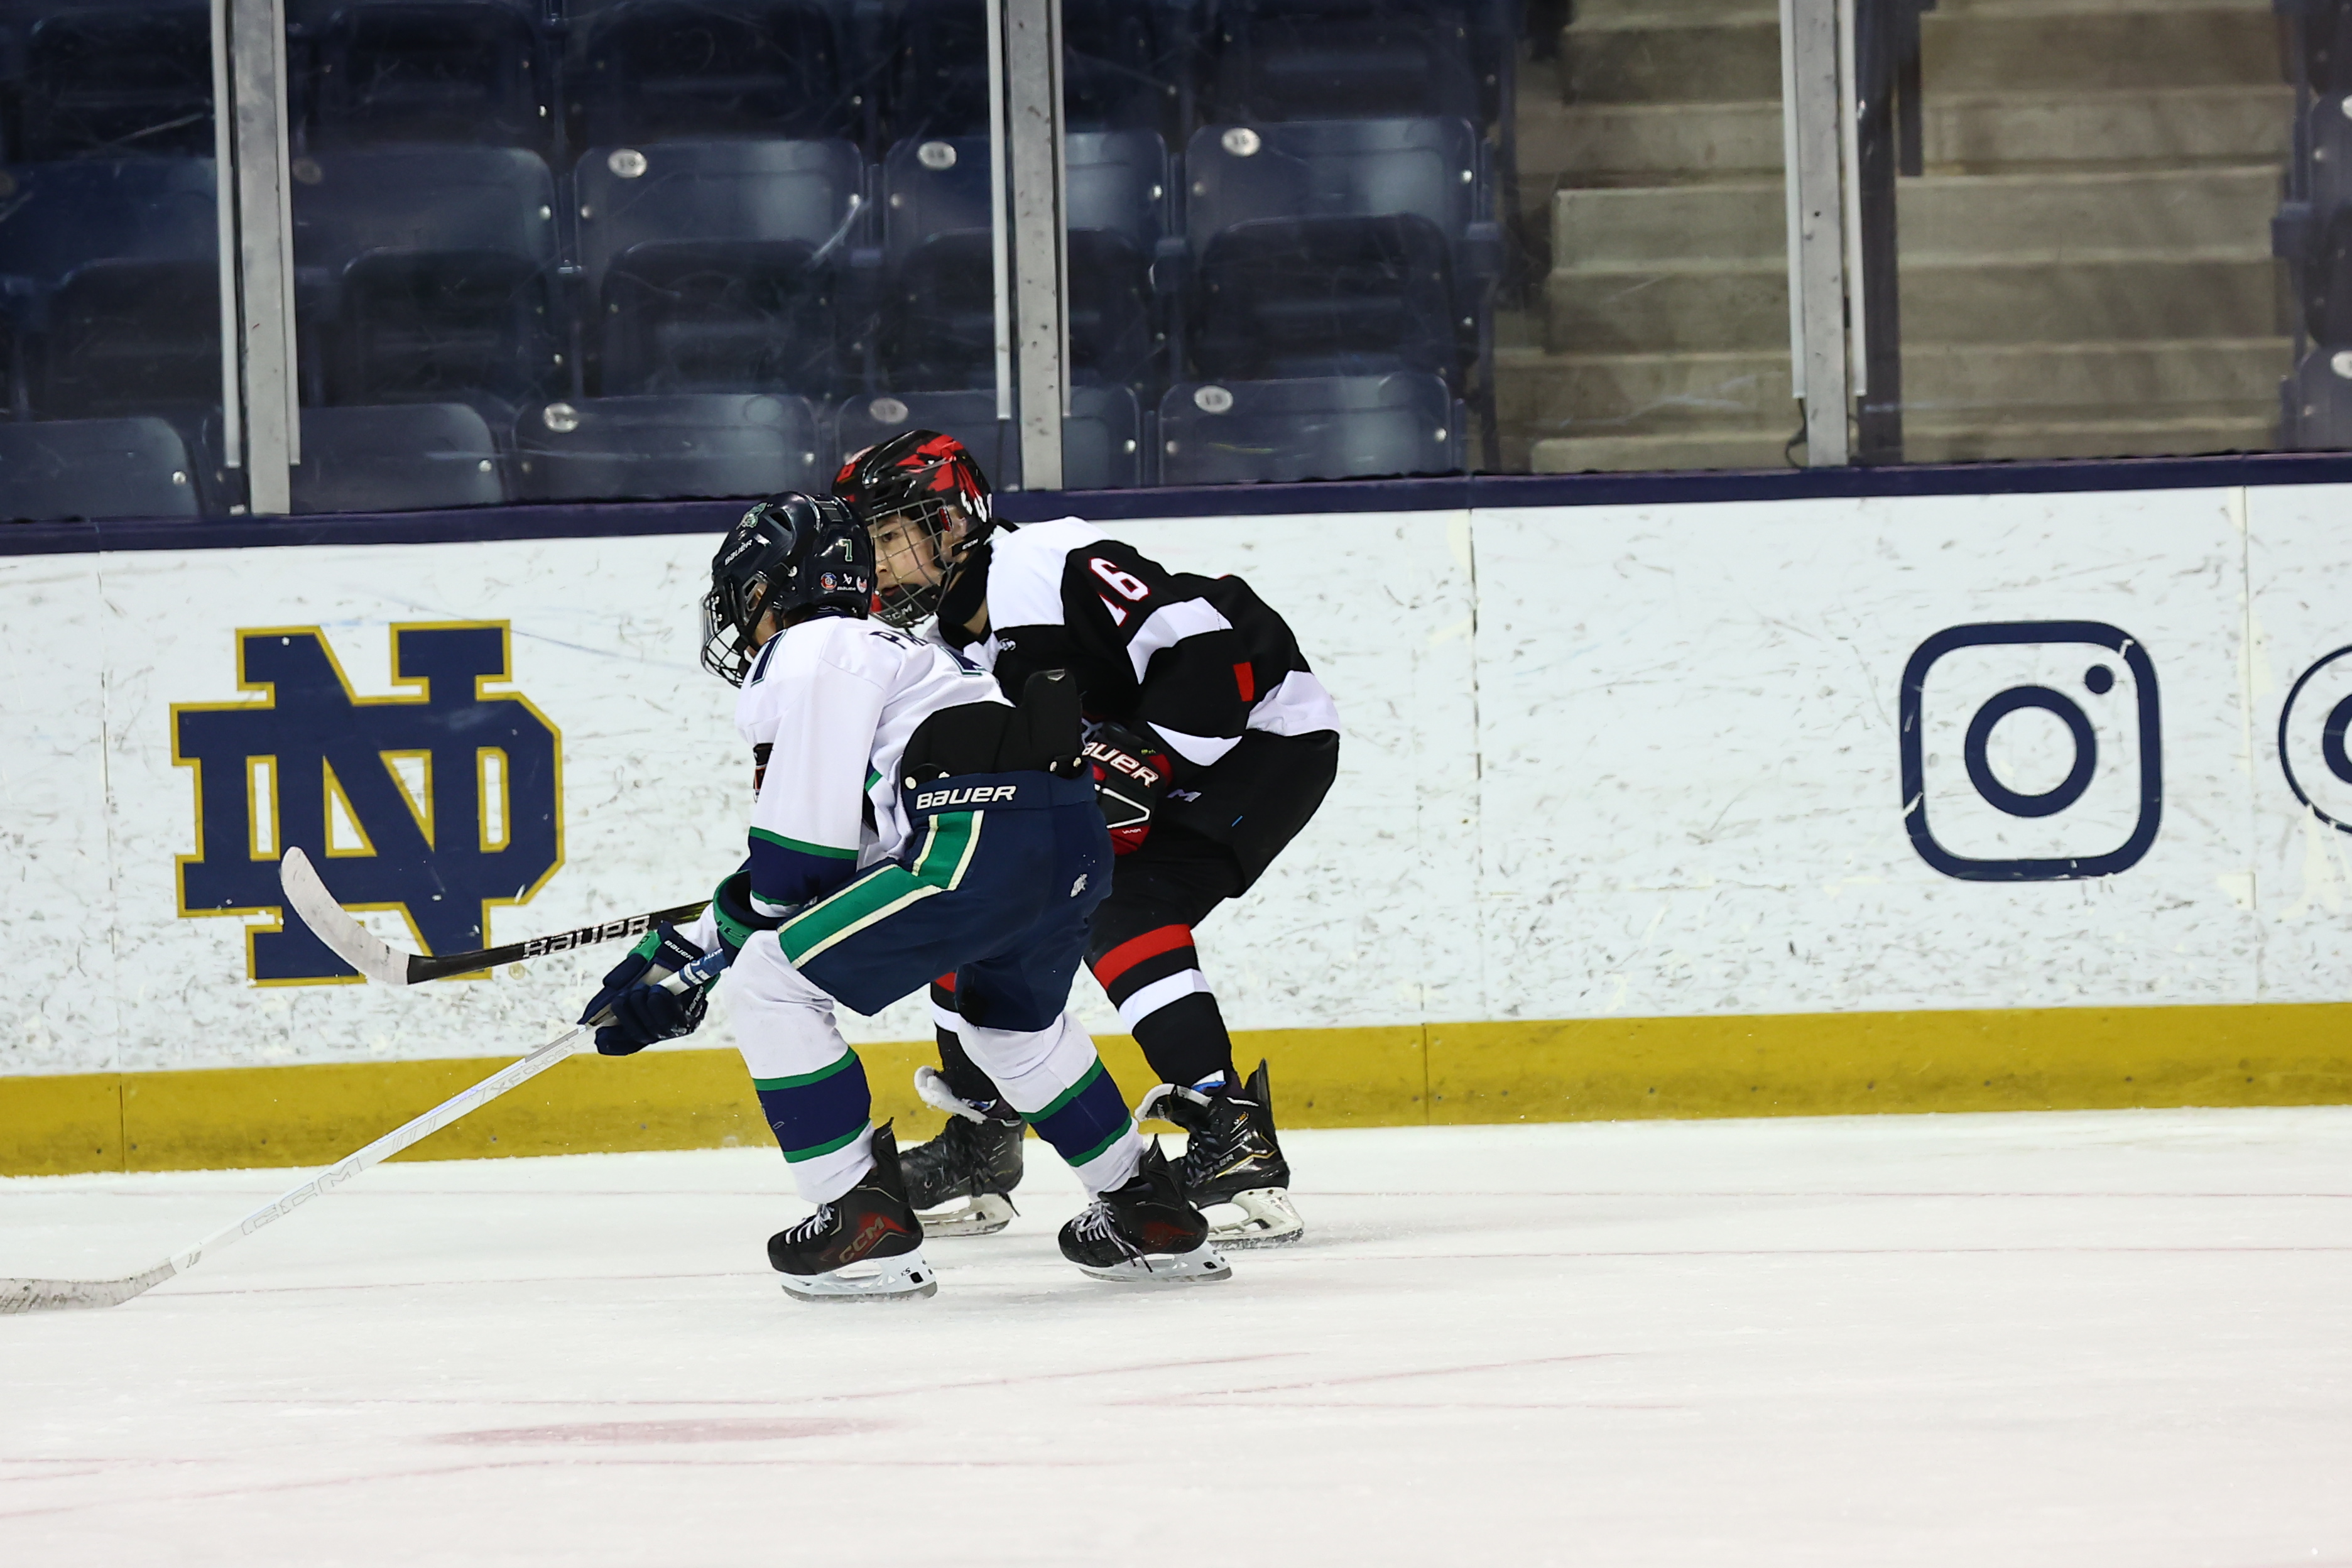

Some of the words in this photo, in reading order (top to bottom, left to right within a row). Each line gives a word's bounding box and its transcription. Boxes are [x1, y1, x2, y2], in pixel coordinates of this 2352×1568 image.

[725, 540, 753, 565] BAUER
[837, 538, 853, 562] 7
[1082, 742, 1160, 788] AUER
[169, 619, 565, 988] ND
[916, 786, 1016, 810] BAUER
[523, 914, 650, 959] BAUER
[664, 940, 694, 961] BAUER
[523, 1041, 577, 1075] GHOST
[839, 1216, 885, 1264] CCM
